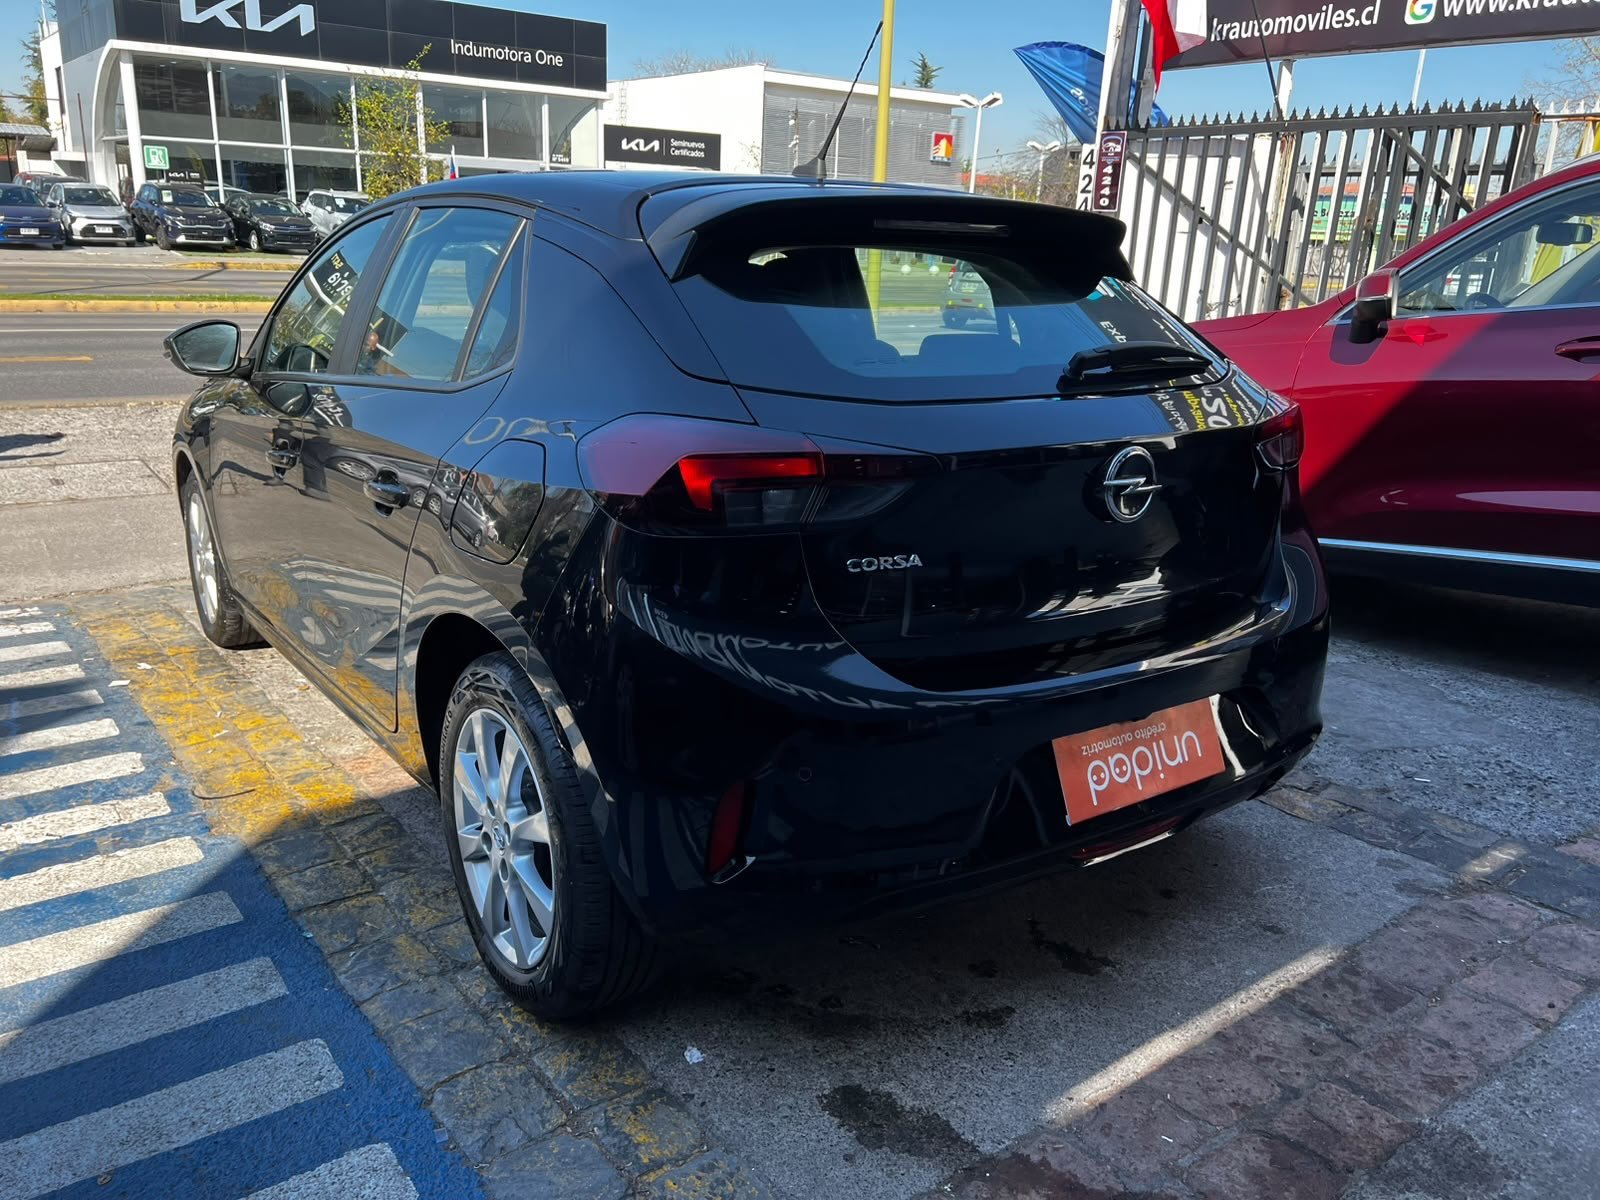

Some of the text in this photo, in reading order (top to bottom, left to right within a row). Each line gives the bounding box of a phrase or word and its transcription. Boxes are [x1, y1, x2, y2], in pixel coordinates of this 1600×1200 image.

[1210, 0, 1382, 42] krautomoviles.cl
[450, 38, 564, 67] Indumotora One
[621, 137, 660, 153] KIA
[670, 138, 705, 149] Seminuevos
[670, 147, 705, 158] Certificados
[846, 553, 923, 573] CORSA
[1134, 721, 1168, 740] crédito
[1080, 732, 1135, 758] automotriz
[1086, 729, 1203, 807] unidad
